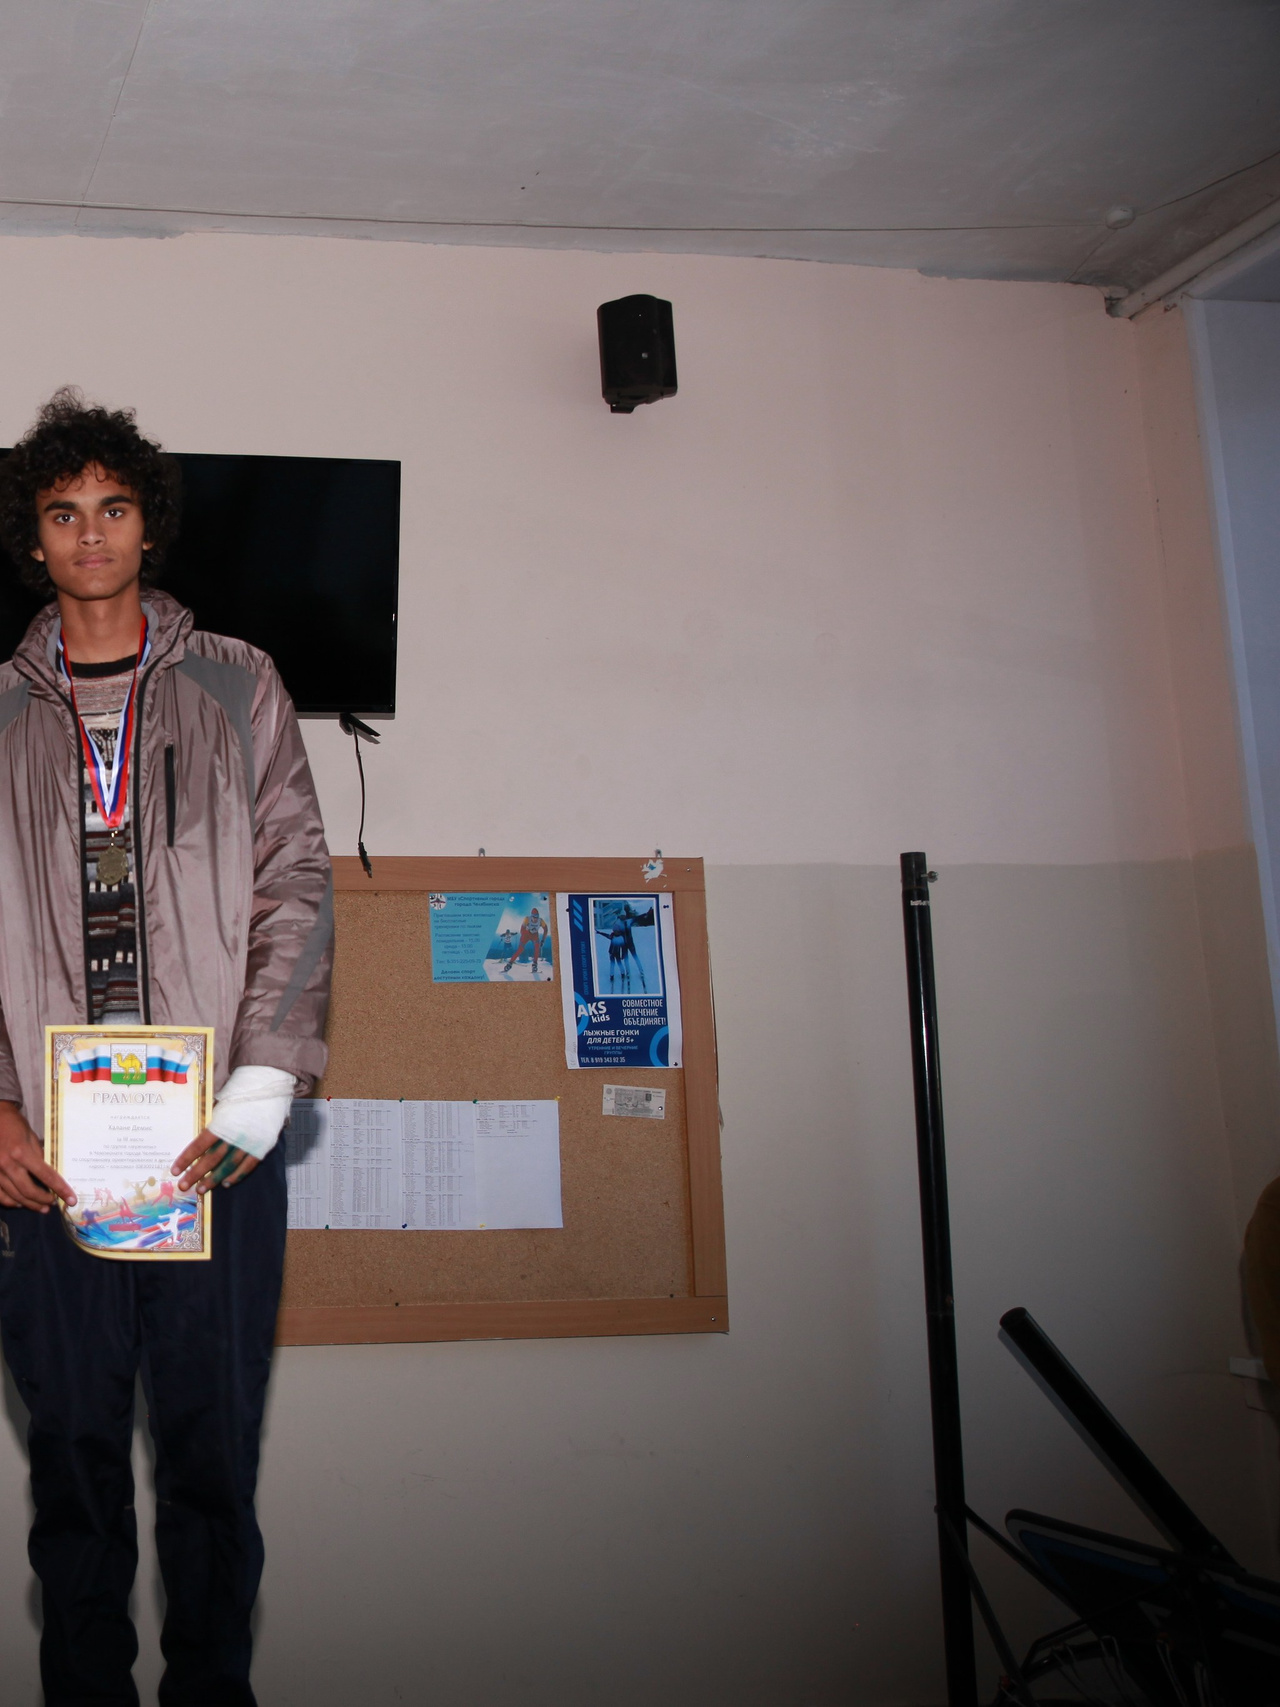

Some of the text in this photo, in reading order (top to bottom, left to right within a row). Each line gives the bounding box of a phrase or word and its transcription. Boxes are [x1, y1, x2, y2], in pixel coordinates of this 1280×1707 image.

[622, 1000, 663, 1008] СОВМЕСТНОЕ
[577, 1001, 607, 1018] AKS
[623, 1008, 659, 1017] УВЛЕЧЕНИЕ
[592, 1014, 610, 1023] kids
[623, 1017, 666, 1026] ОБЪЕДИНЯЕТ!
[92, 1093, 164, 1104] ГРАМОТА
